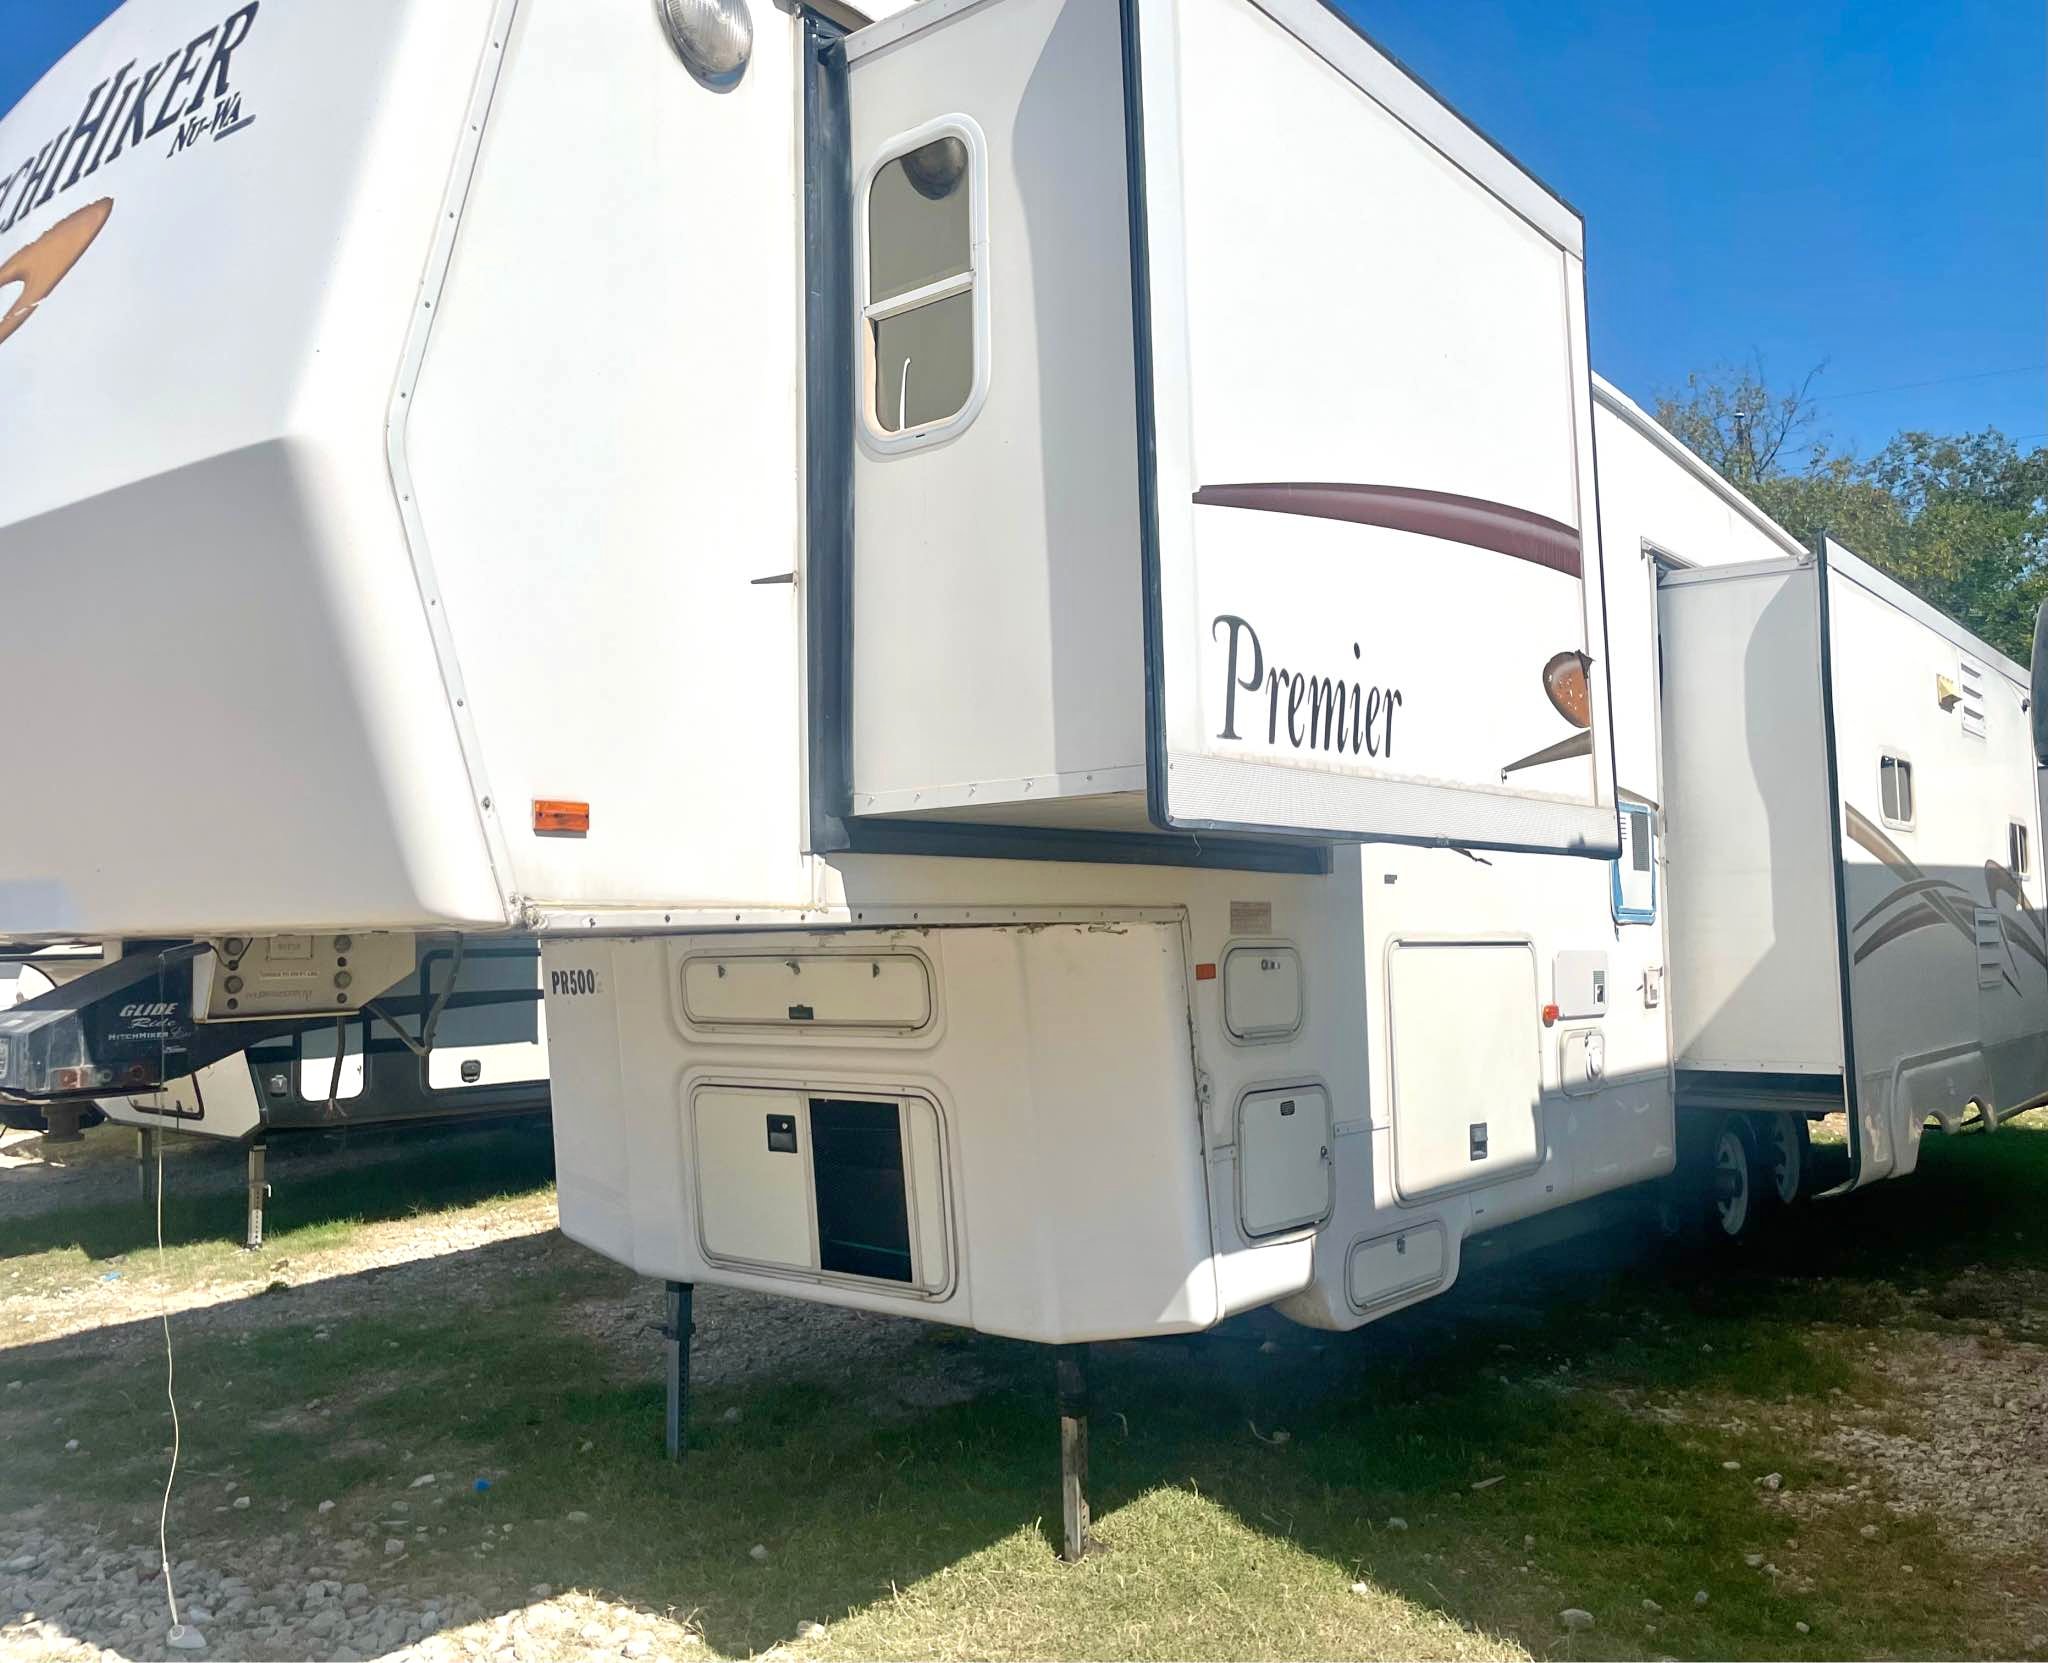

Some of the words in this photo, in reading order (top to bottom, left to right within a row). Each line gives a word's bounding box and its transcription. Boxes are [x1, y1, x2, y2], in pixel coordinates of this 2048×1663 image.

[1212, 614, 1402, 758] Premier
[119, 1002, 179, 1017] GLIDE
[128, 1017, 176, 1029] Ride
